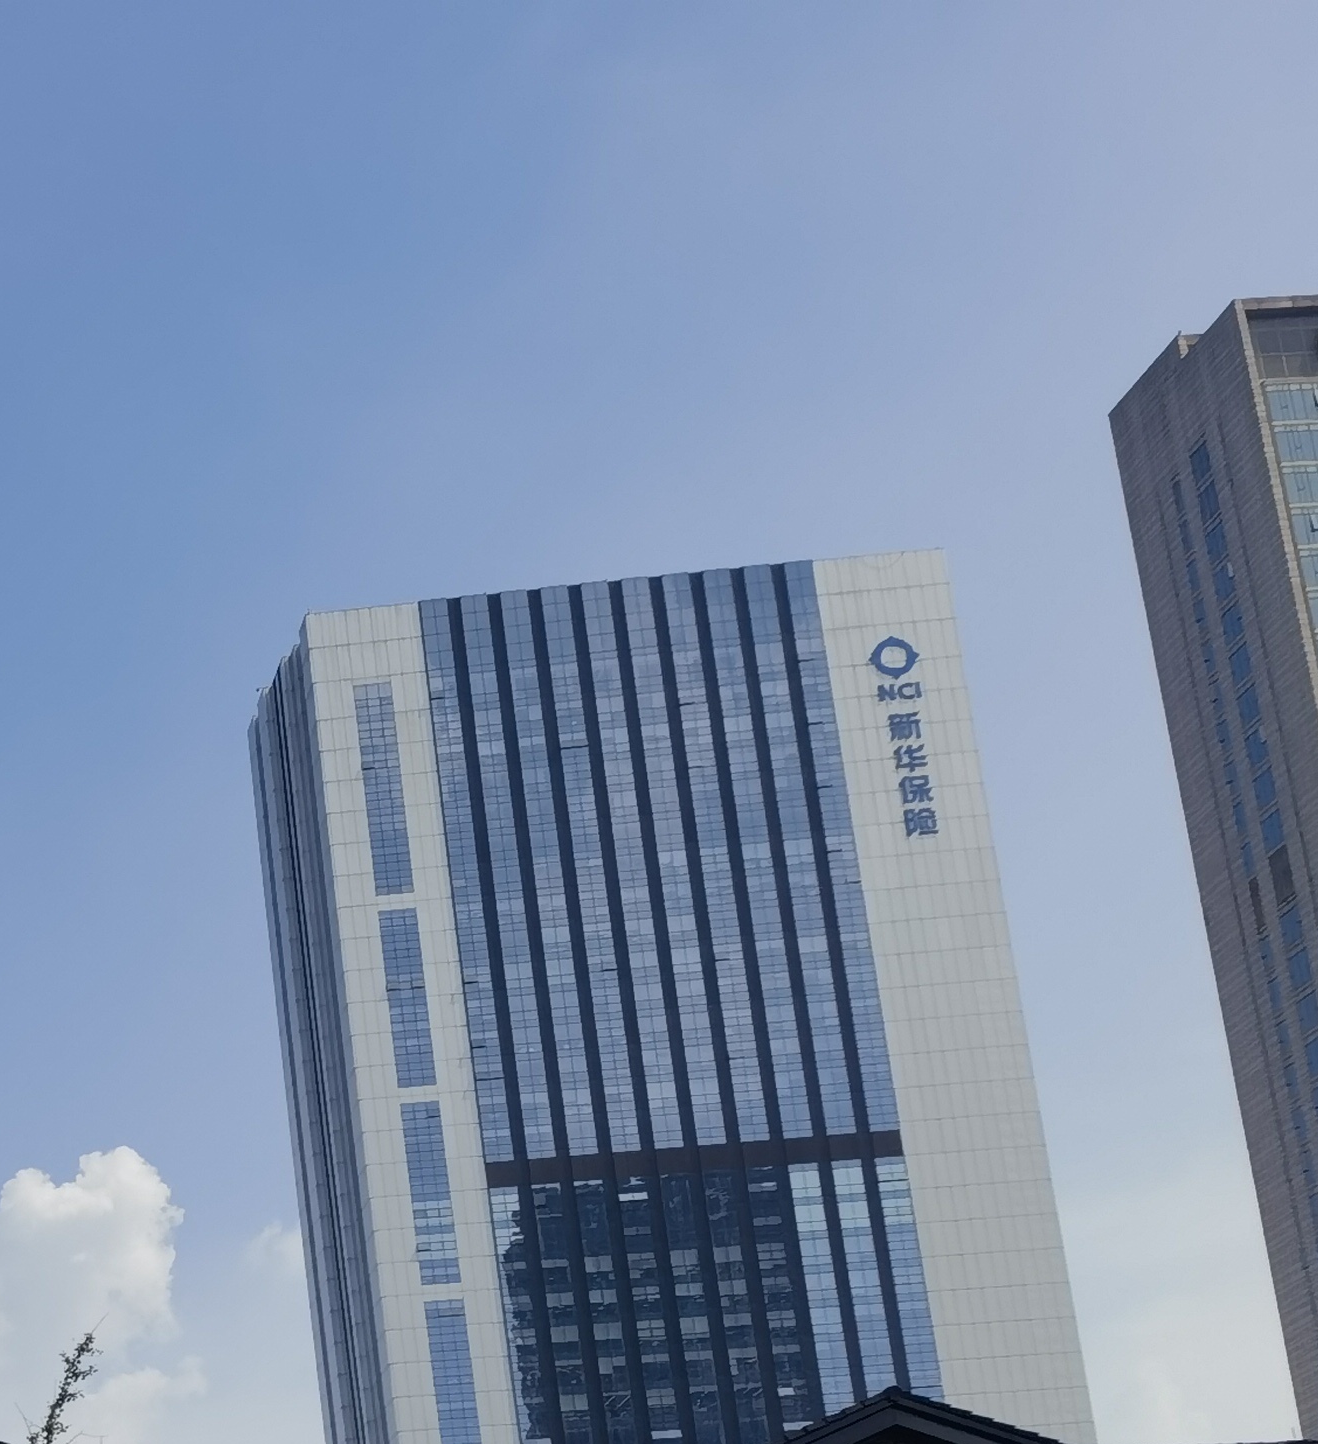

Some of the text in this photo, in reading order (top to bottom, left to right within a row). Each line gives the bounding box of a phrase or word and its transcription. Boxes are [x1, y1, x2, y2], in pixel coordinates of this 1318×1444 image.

[877, 682, 922, 701] NCI
[887, 711, 939, 837] 新华保险
